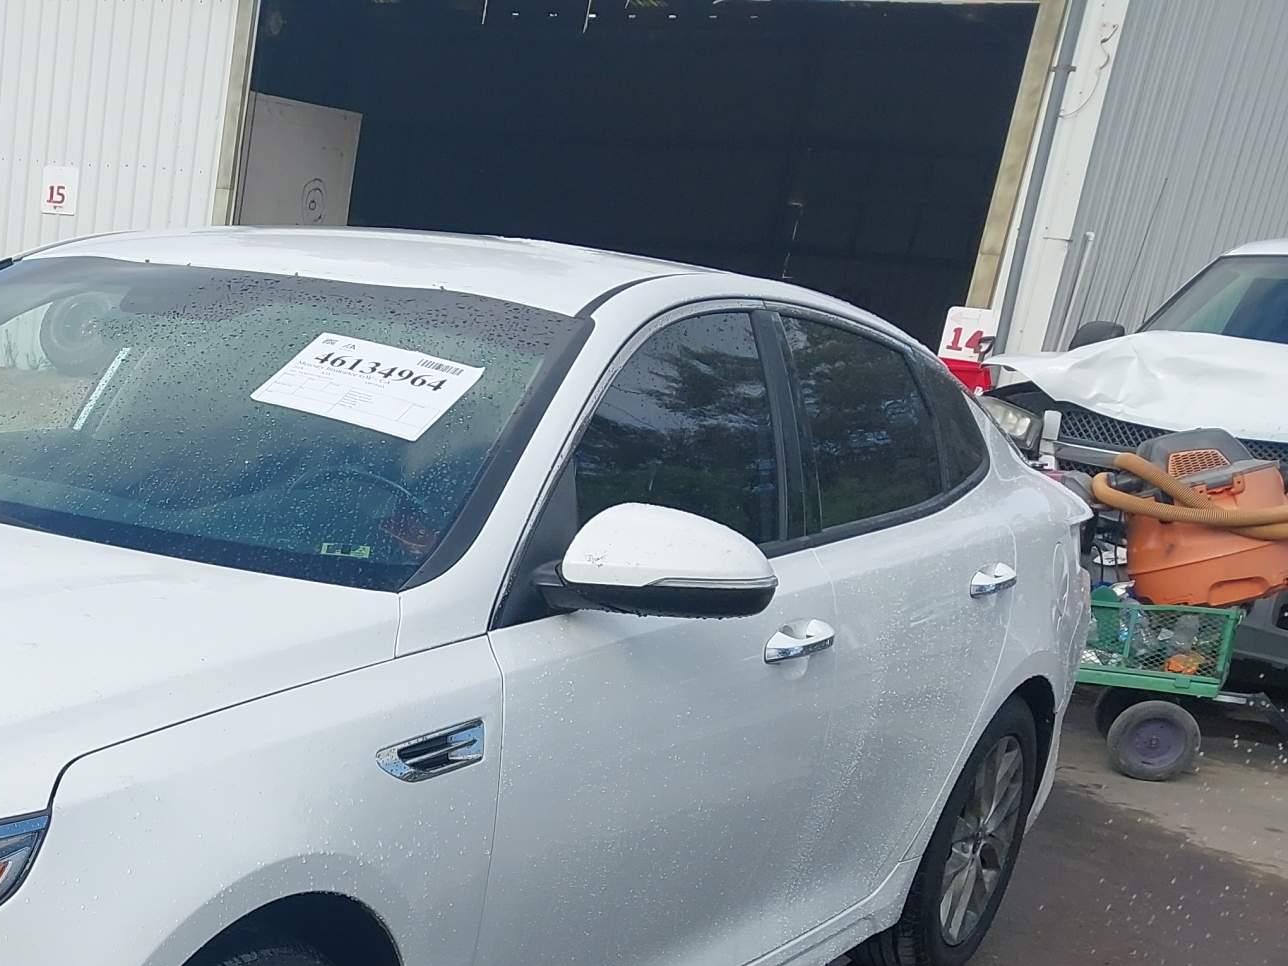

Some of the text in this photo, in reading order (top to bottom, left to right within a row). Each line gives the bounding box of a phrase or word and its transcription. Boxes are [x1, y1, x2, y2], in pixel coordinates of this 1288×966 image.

[46, 185, 66, 204] 15
[946, 327, 984, 354] 14
[314, 352, 448, 392] 46134964
